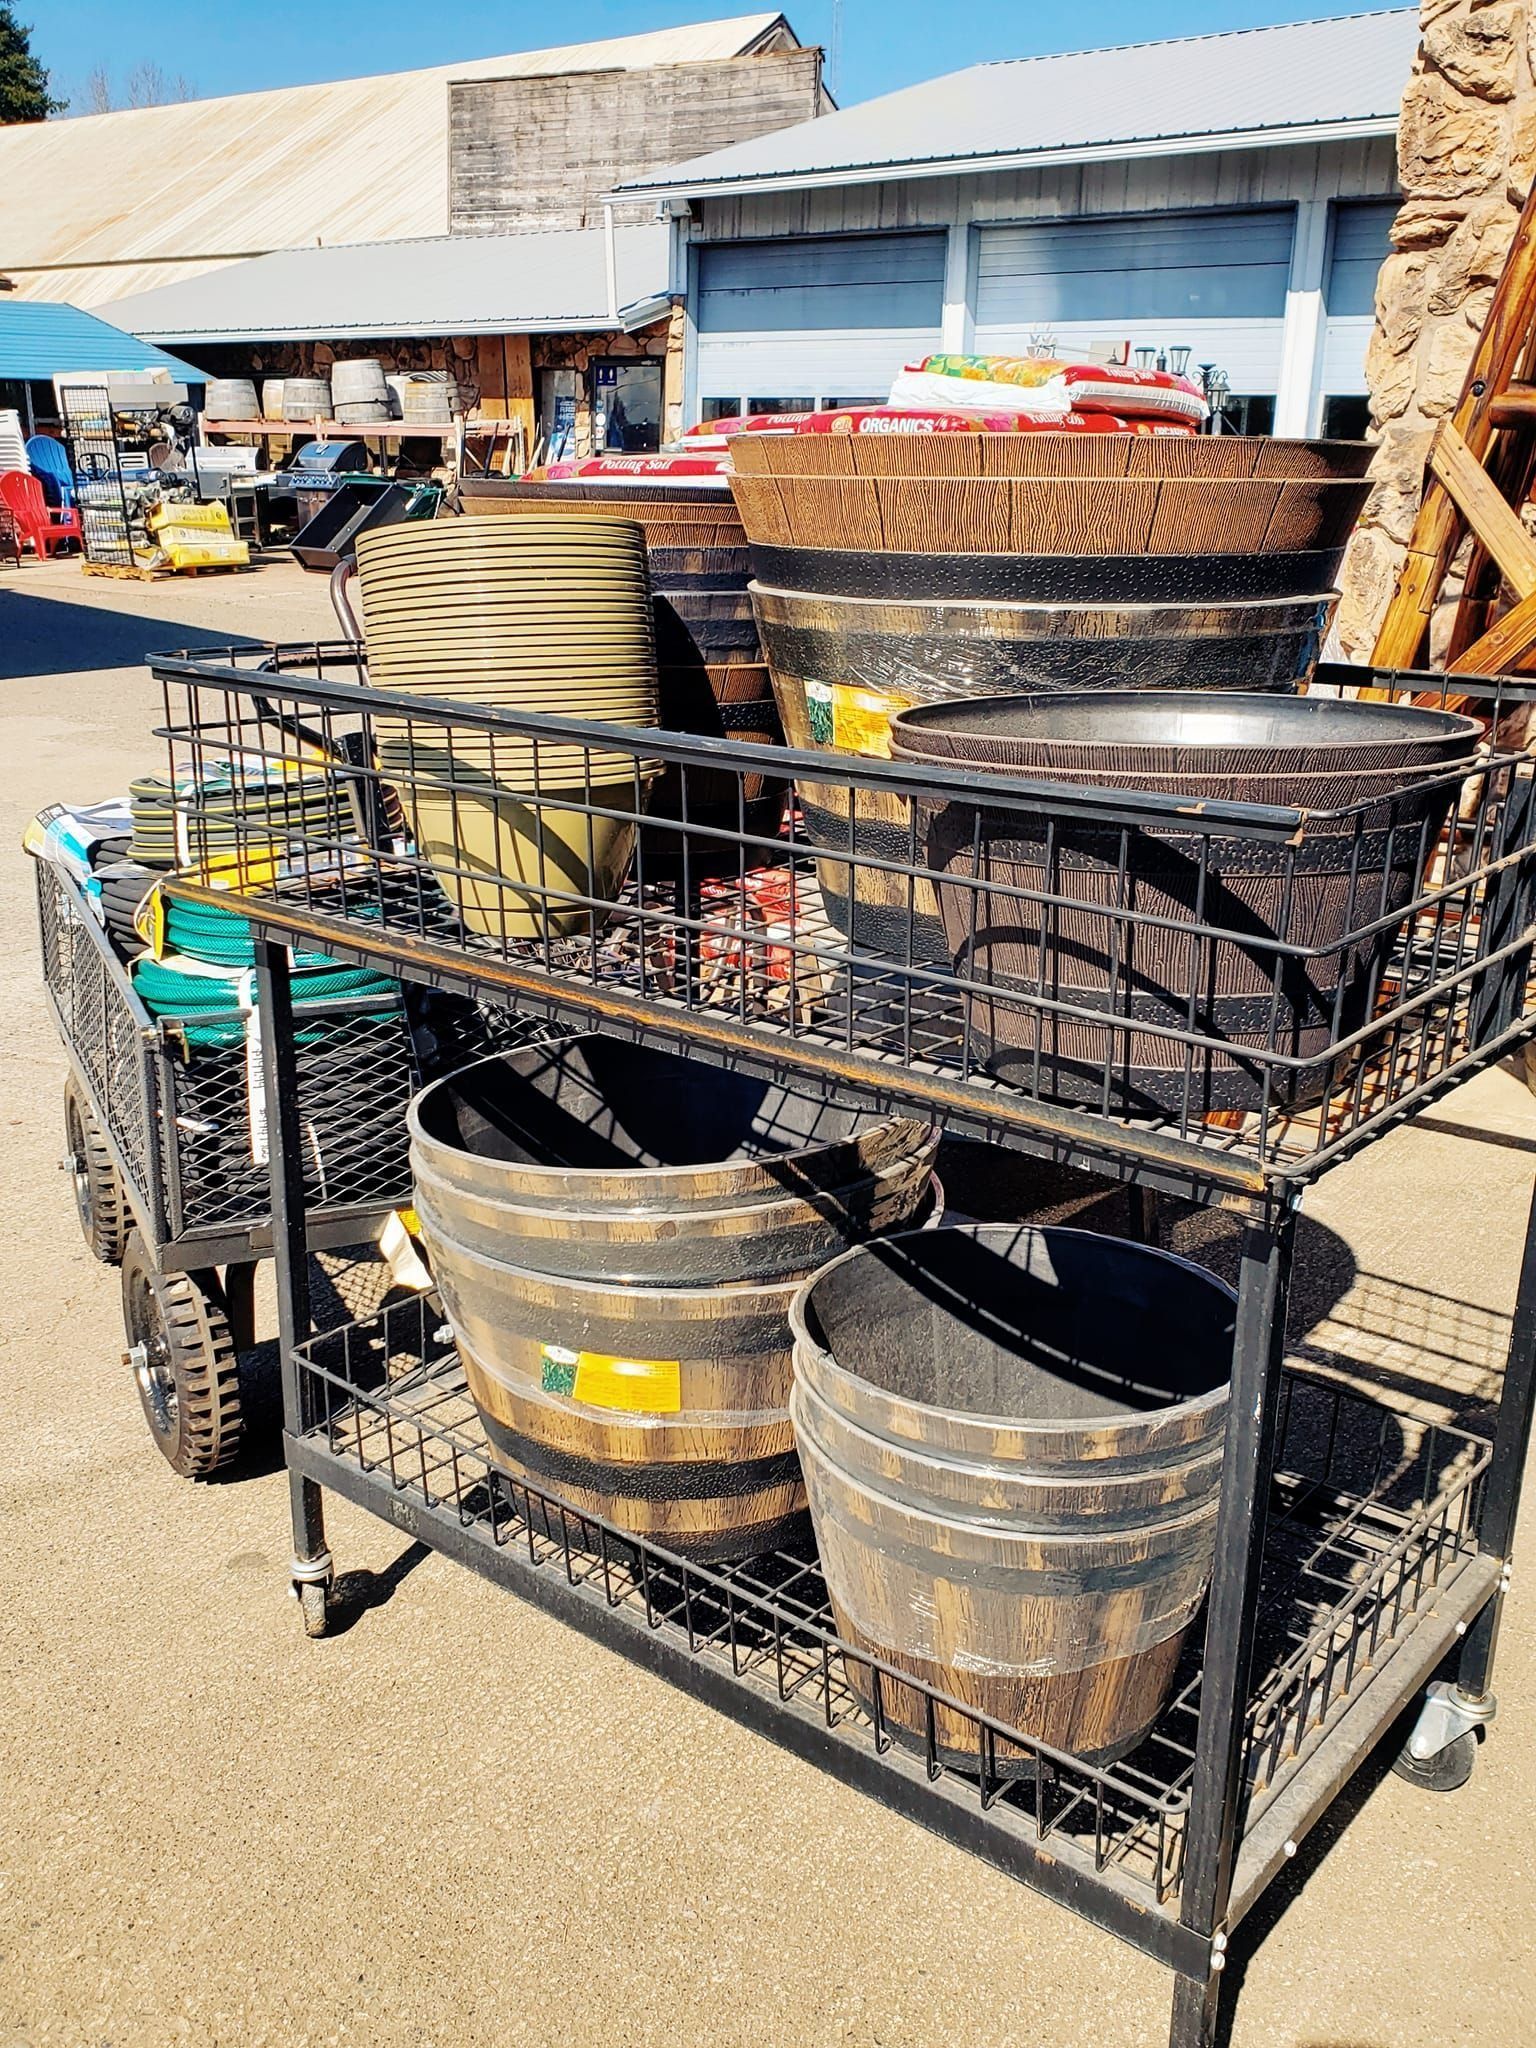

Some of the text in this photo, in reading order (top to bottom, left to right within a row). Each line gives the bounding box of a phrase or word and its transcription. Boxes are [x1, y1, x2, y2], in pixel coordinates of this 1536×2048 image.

[859, 417, 934, 433] ORGANICS
[599, 458, 674, 475] Potting Soil
